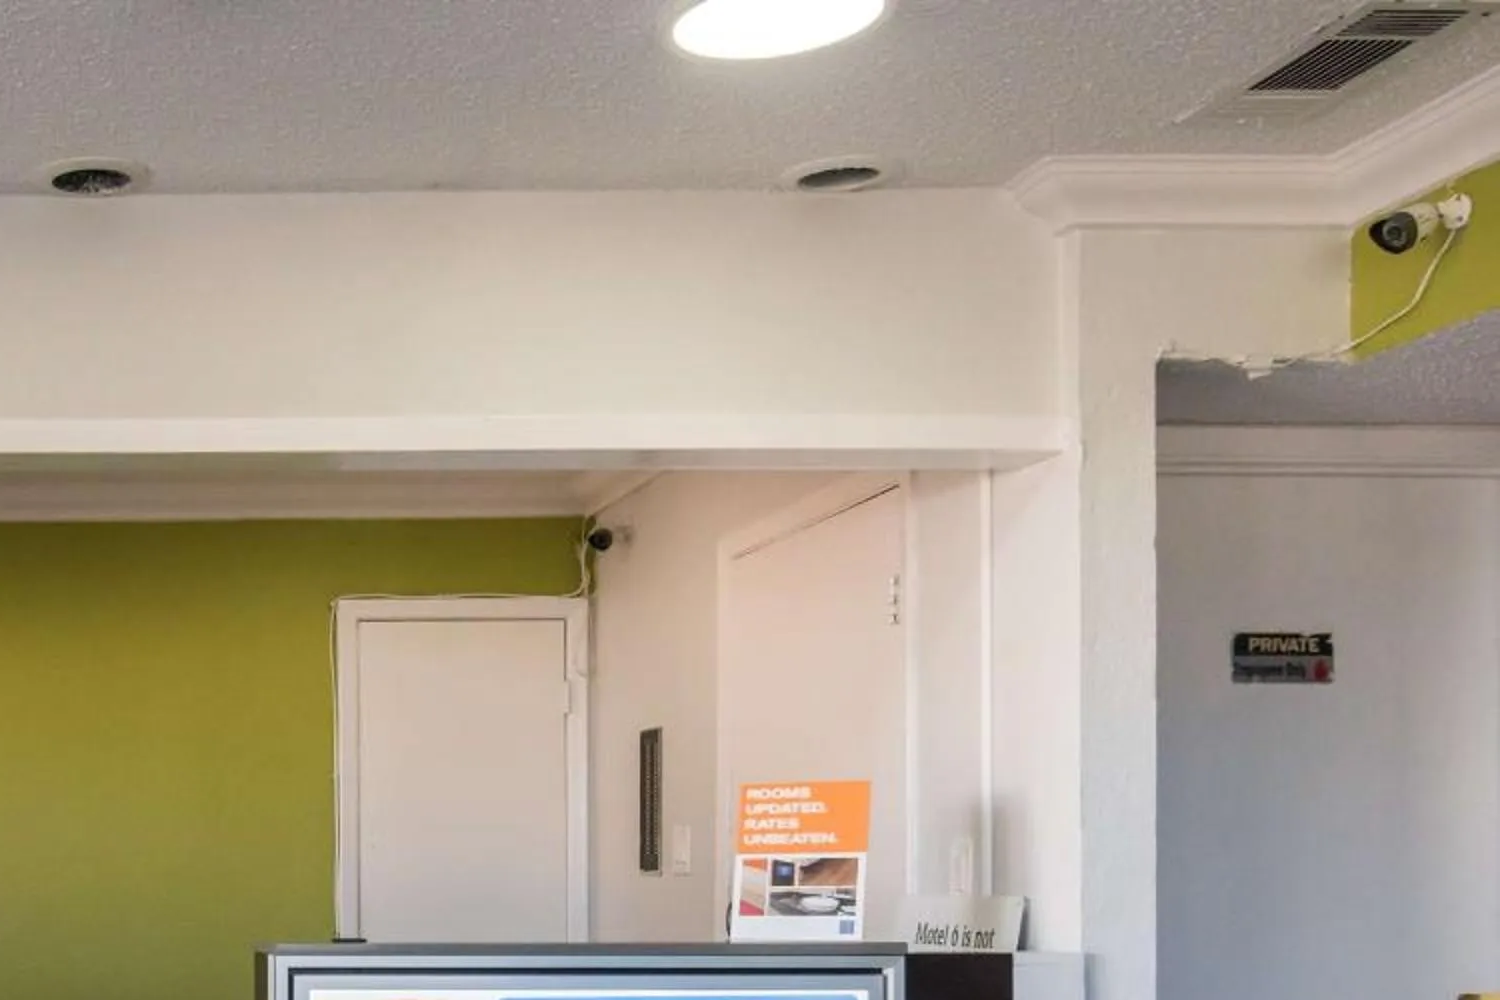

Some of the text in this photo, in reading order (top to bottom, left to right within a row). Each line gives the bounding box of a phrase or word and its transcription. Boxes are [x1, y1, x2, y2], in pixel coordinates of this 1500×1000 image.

[1249, 638, 1319, 652] PRIVATE
[746, 786, 811, 799] ROOMS
[743, 817, 800, 830] RATES
[915, 922, 994, 949] Motel 6 is not
